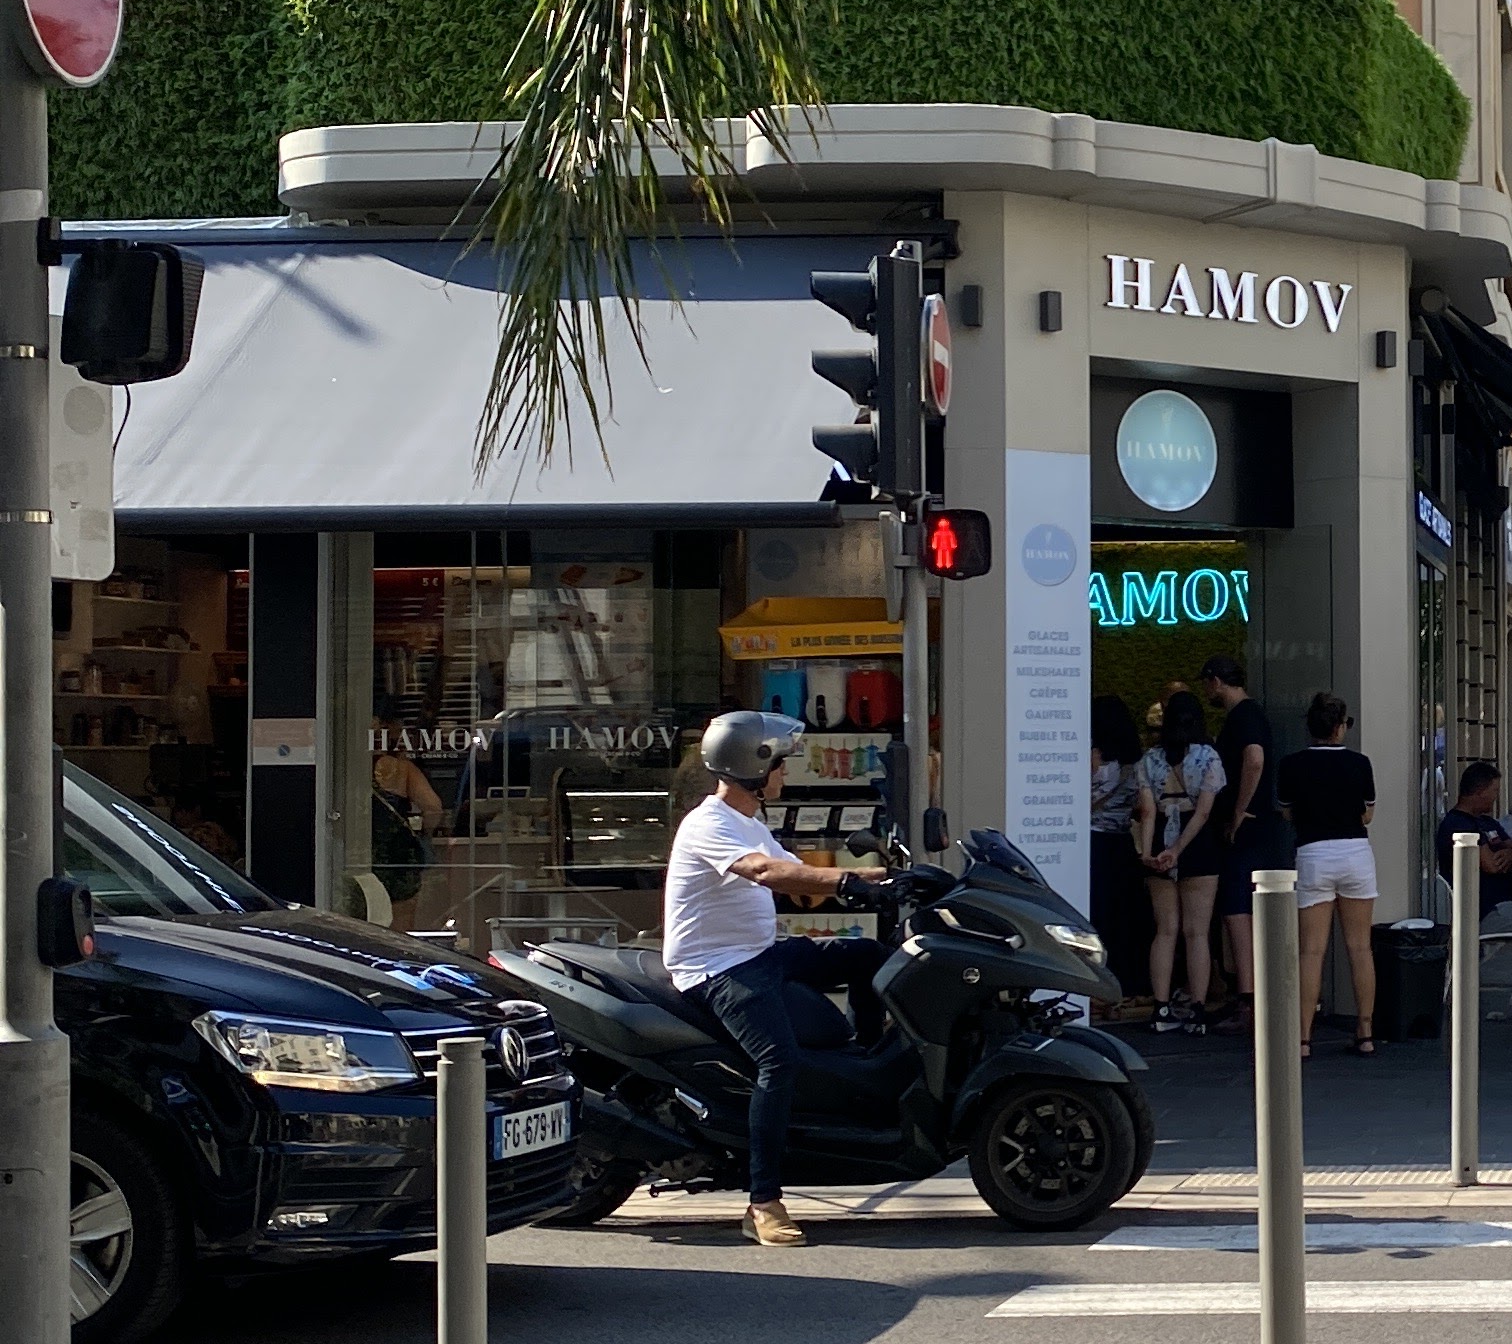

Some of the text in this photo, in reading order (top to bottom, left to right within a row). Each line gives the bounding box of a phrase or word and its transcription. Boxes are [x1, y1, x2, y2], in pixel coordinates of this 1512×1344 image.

[1103, 254, 1353, 333] HAMOV
[1027, 630, 1069, 641] GLACES
[1013, 645, 1081, 656] ARTISANALES
[1016, 666, 1081, 677] MILKSHAKES
[1029, 686, 1068, 698] CRÊPES
[1025, 709, 1072, 720] GAUFRES
[368, 728, 496, 751] HAMOV
[547, 726, 679, 750] HAMOV
[1019, 731, 1078, 741] BUBBLE TEA
[1018, 752, 1079, 762] SMOOTHIES
[1026, 771, 1071, 783] FRAPPÉS
[1022, 792, 1073, 805] GRANITÉS
[1022, 816, 1064, 826] GLACES
[1018, 832, 1078, 844] L'ITALIENNE
[1035, 851, 1062, 864] CAFÉ
